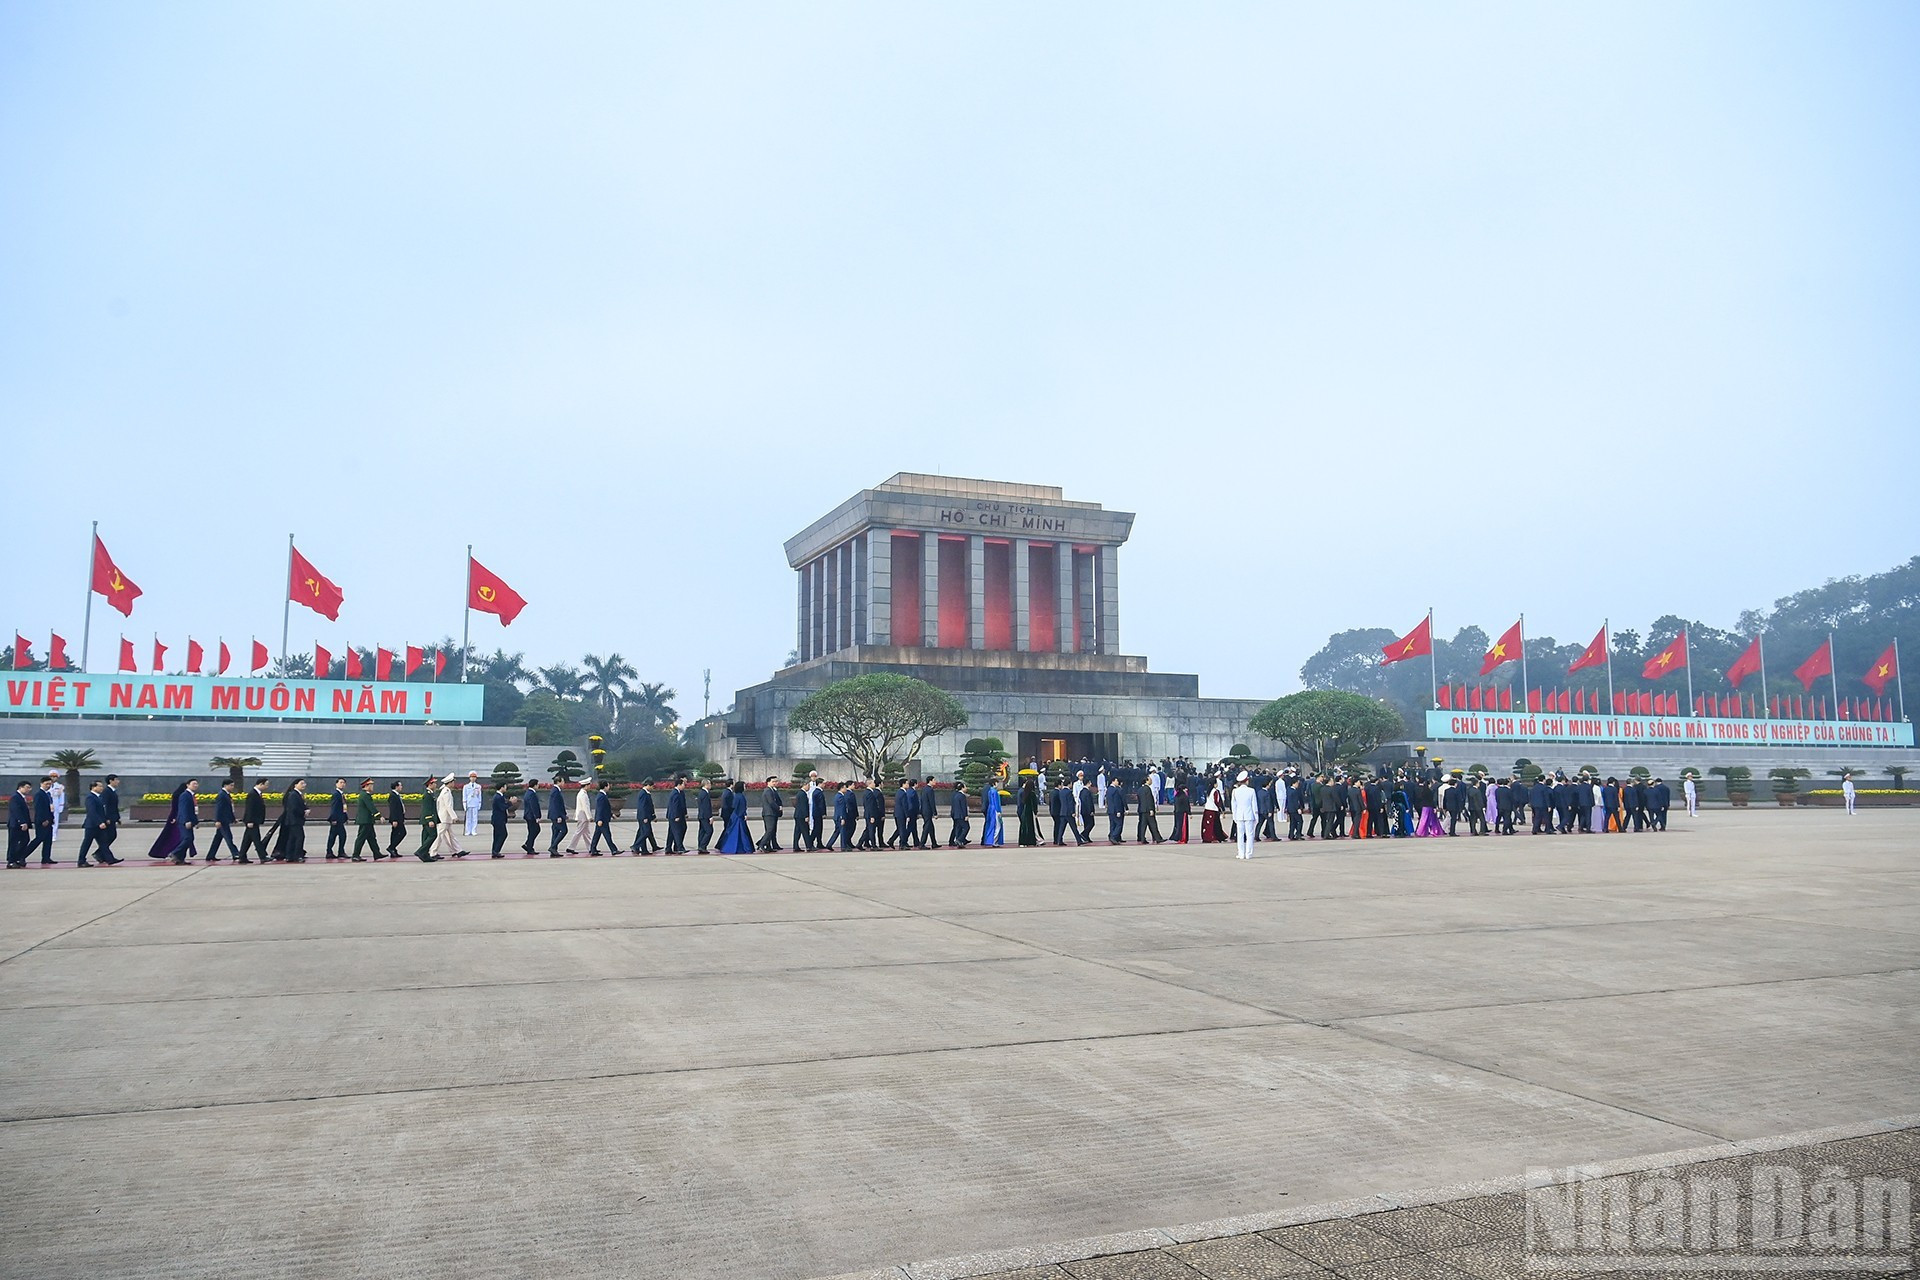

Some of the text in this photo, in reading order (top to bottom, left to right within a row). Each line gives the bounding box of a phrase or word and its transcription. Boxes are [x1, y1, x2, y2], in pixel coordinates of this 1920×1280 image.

[7, 676, 92, 711] VIỆT
[110, 682, 193, 709] NAM
[211, 682, 316, 712] MUÔN
[332, 684, 408, 714] NĂM
[1451, 712, 1479, 735] CHỦ
[1484, 717, 1514, 738] TỊCH
[1519, 712, 1537, 735] HỒ
[1541, 716, 1564, 736] CHÍ
[1569, 719, 1602, 736] MINH
[1623, 720, 1644, 740] ĐẠI
[1649, 716, 1681, 738] SỐNG
[1711, 723, 1749, 739] TRONG
[1753, 721, 1768, 742] SỰ
[1771, 722, 1810, 743] NGHIỆP
[1814, 721, 1835, 740] CỦA
[1838, 723, 1873, 741] CHÚNG
[1876, 727, 1889, 741] TA
